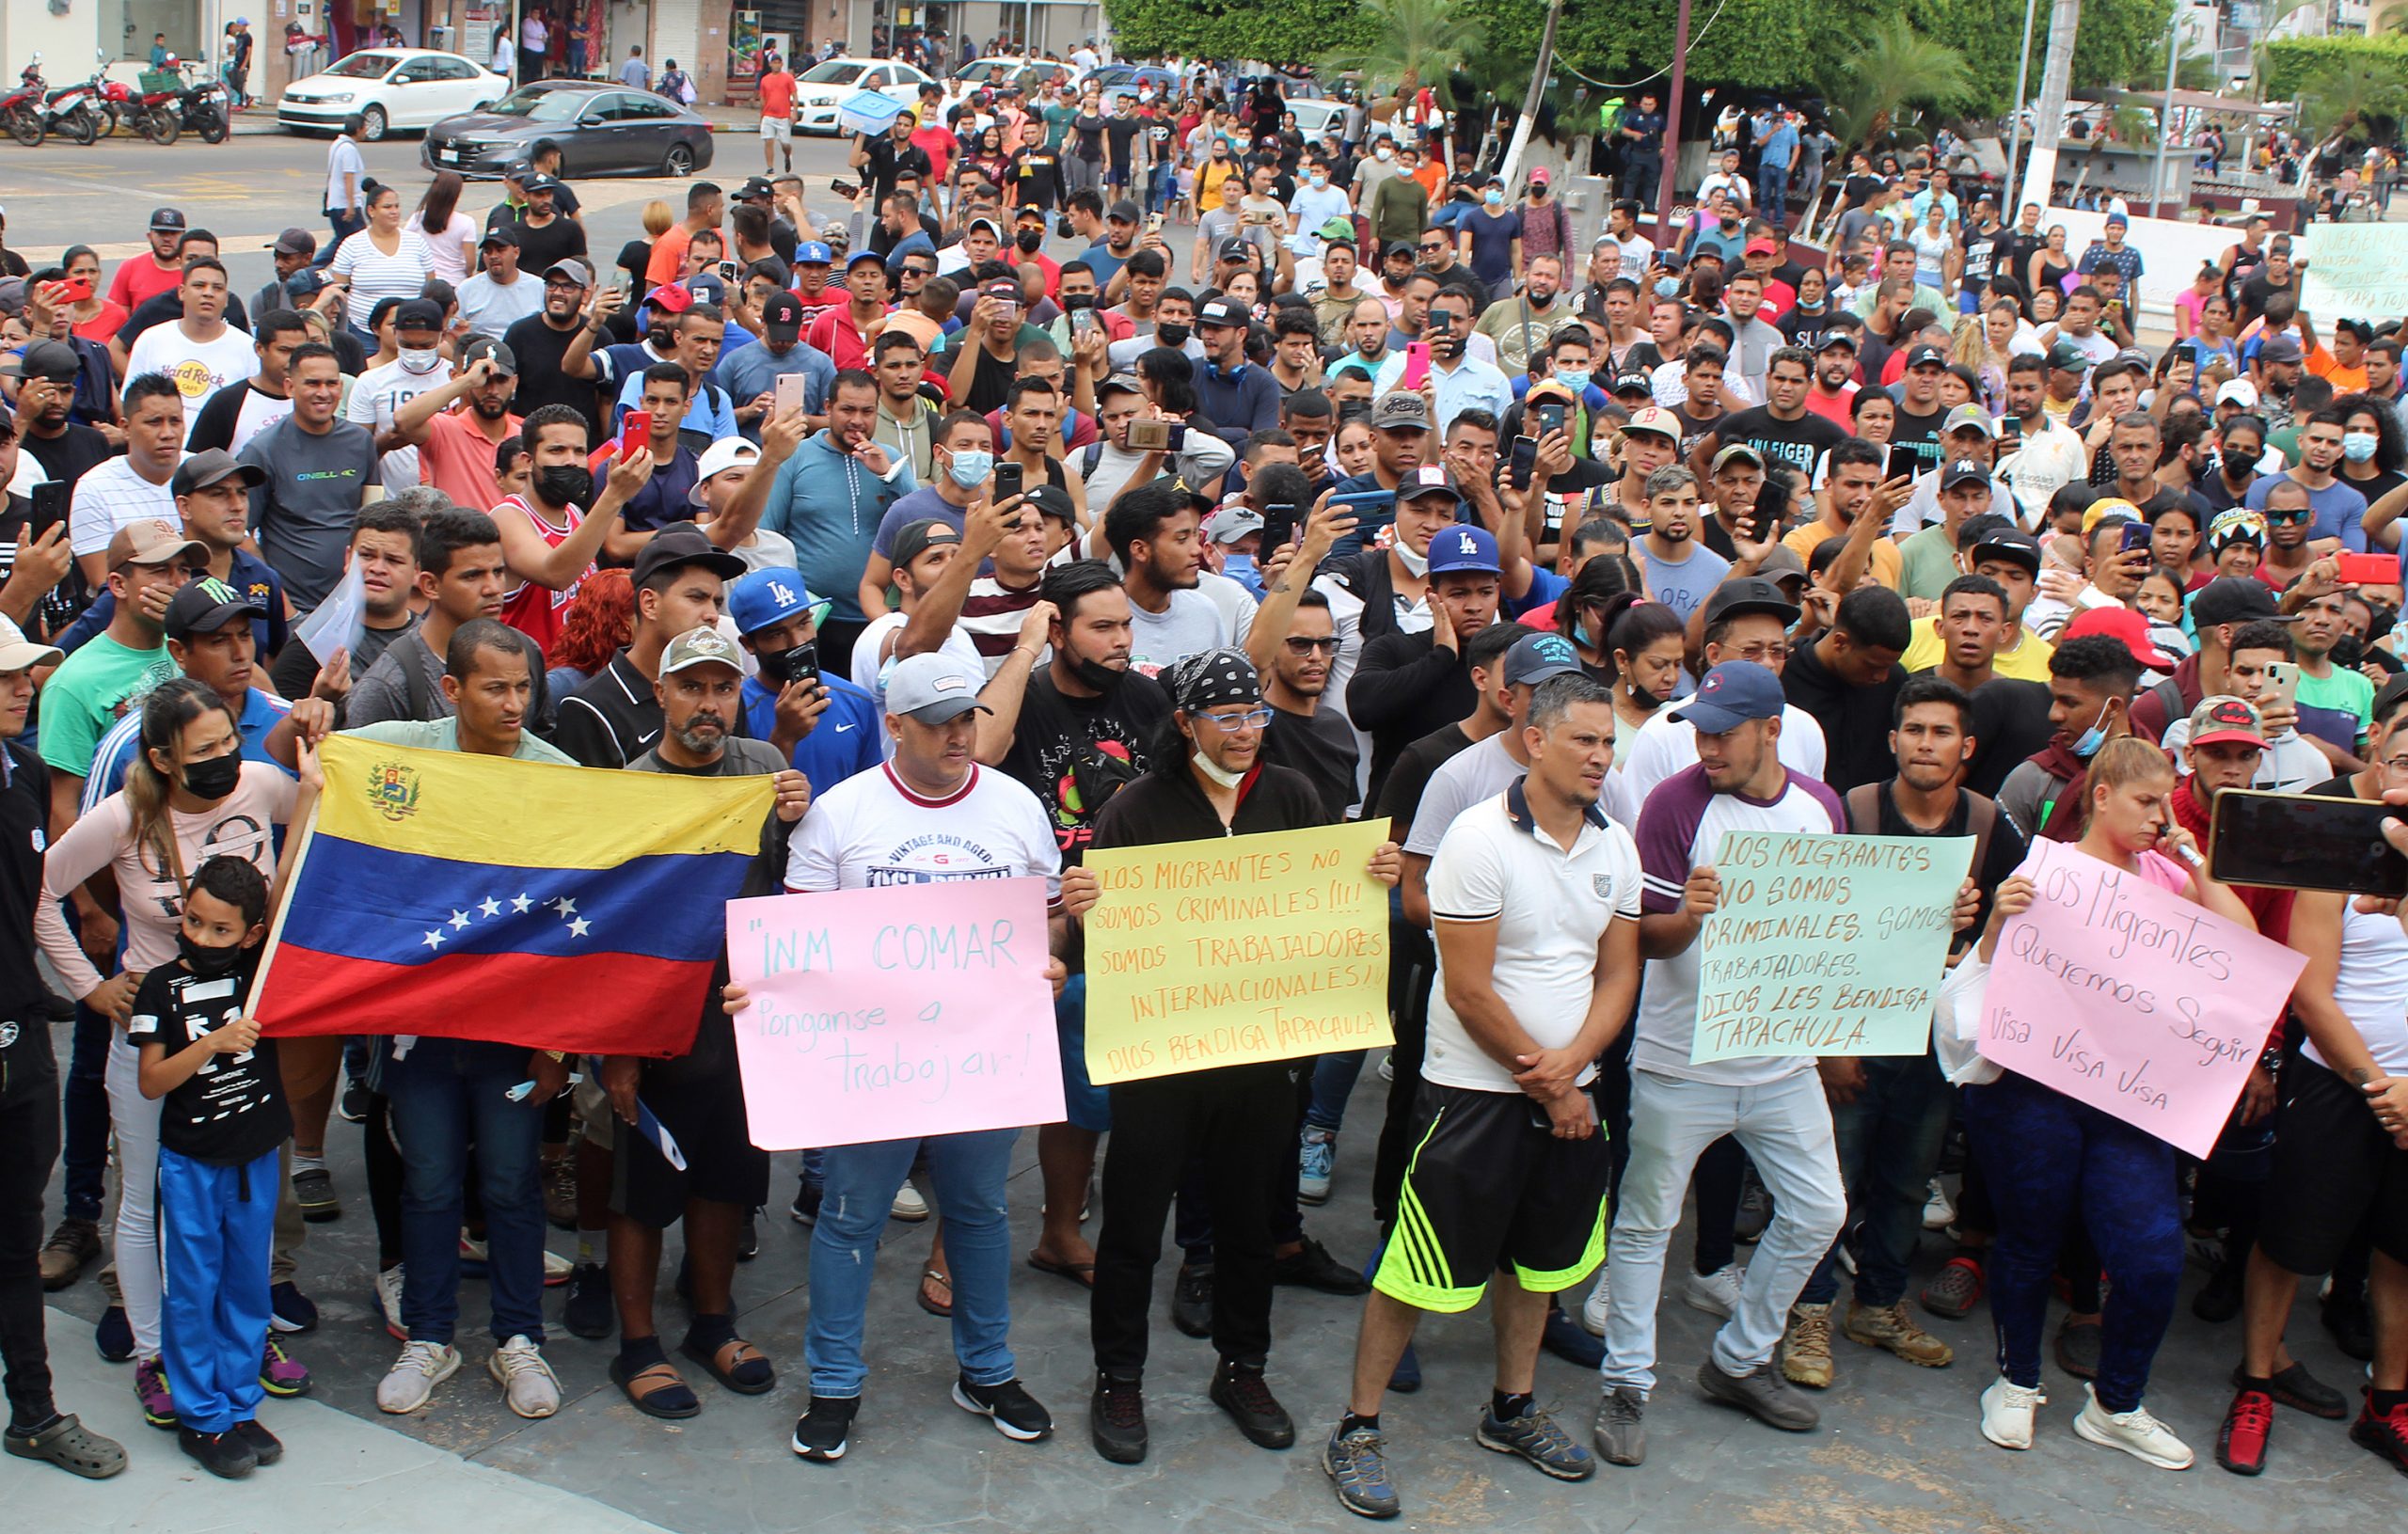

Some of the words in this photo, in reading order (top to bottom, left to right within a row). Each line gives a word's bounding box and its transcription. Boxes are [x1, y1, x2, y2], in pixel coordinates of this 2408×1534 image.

[1459, 531, 1478, 555] LA
[767, 580, 798, 609] LA
[1102, 863, 1145, 892] LOS
[1154, 850, 1292, 891] MIGRANTES
[1311, 847, 1341, 872] NO
[1718, 833, 1771, 869] LOS
[1776, 838, 1930, 872] MIGRANTES
[1766, 876, 1853, 907] SOMOS
[1095, 901, 1162, 931] SOMOS
[1877, 905, 1954, 941] SOMOS
[873, 918, 1019, 971] COMAR
[1100, 944, 1167, 975] SOMOS
[1188, 926, 1384, 968] TRABAJADORES
[1702, 985, 1763, 1022] DIOS
[1770, 985, 1823, 1013] LES
[1834, 984, 1933, 1013] BENDIGA
[1107, 1038, 1156, 1075] DIOS
[1168, 1023, 1271, 1066] BENDIGA
